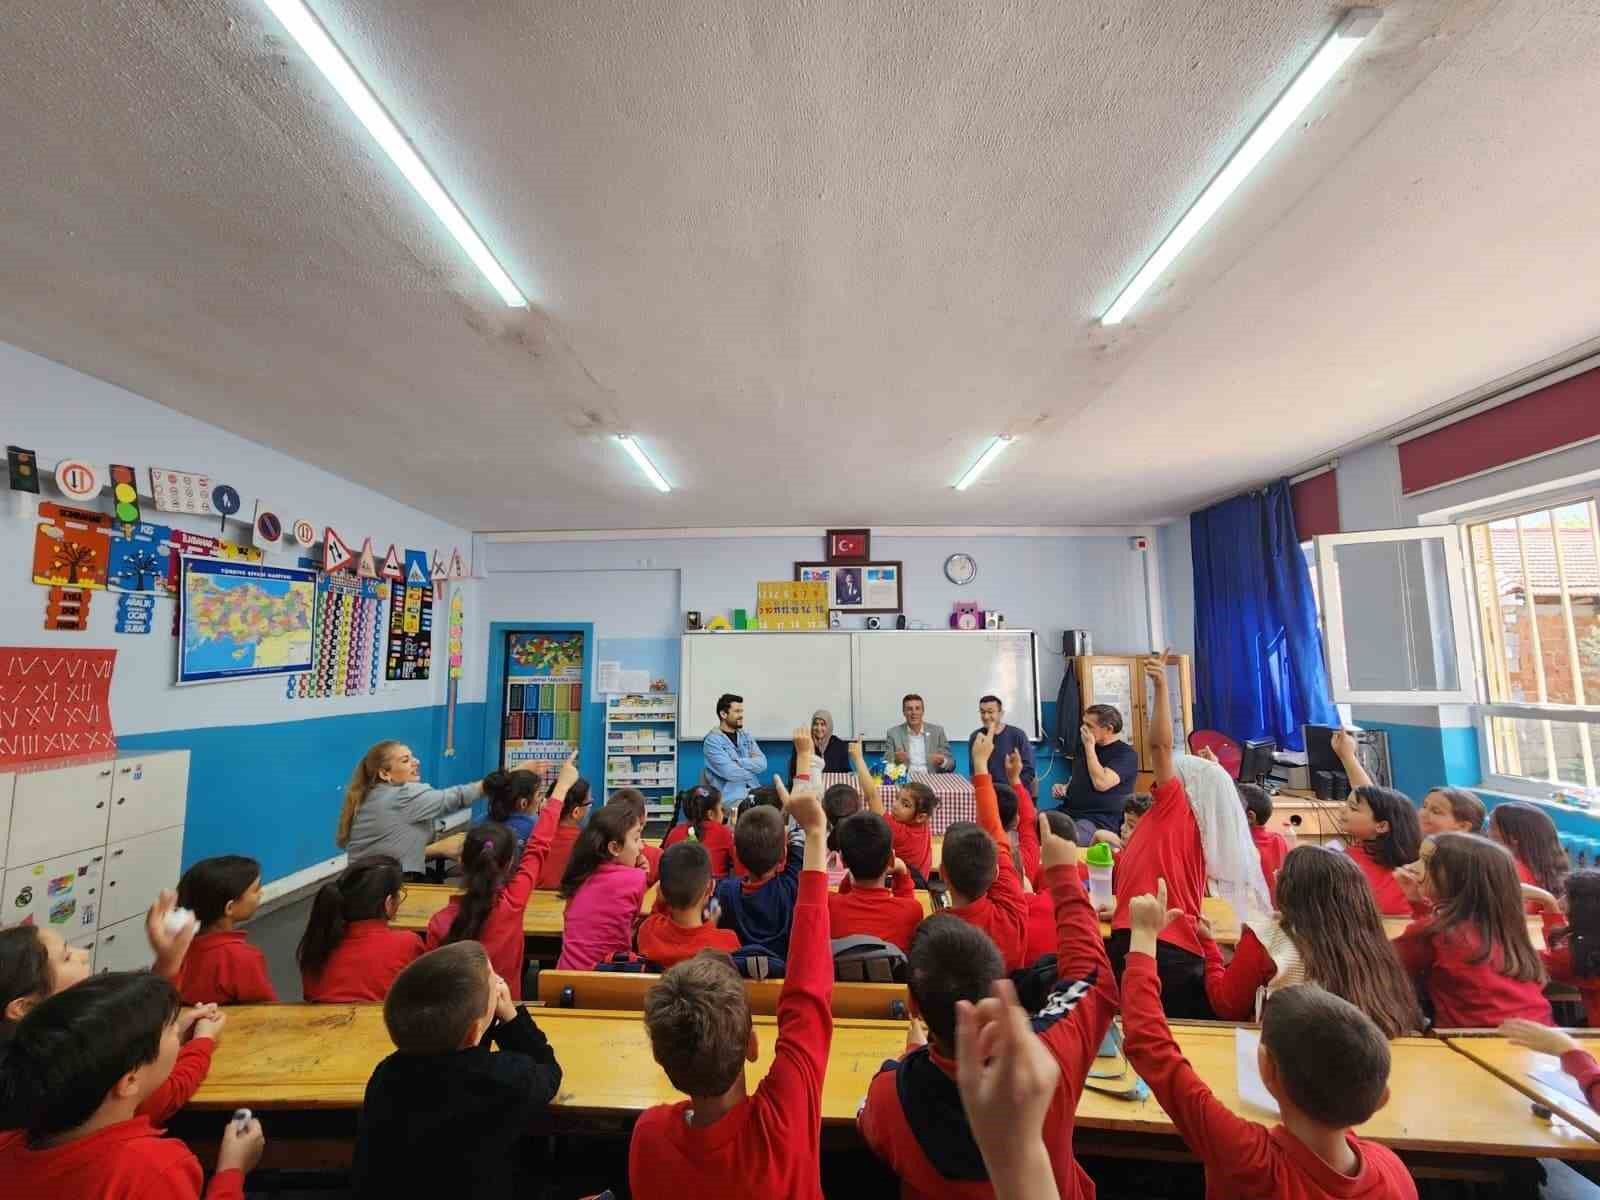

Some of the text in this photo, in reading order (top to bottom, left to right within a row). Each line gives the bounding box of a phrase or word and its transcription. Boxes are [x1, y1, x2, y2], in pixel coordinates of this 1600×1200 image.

[8, 656, 112, 678] IV V VI VII
[34, 682, 57, 703] XI
[66, 682, 92, 703] XII
[25, 701, 59, 726] XV
[84, 730, 117, 750] XX
